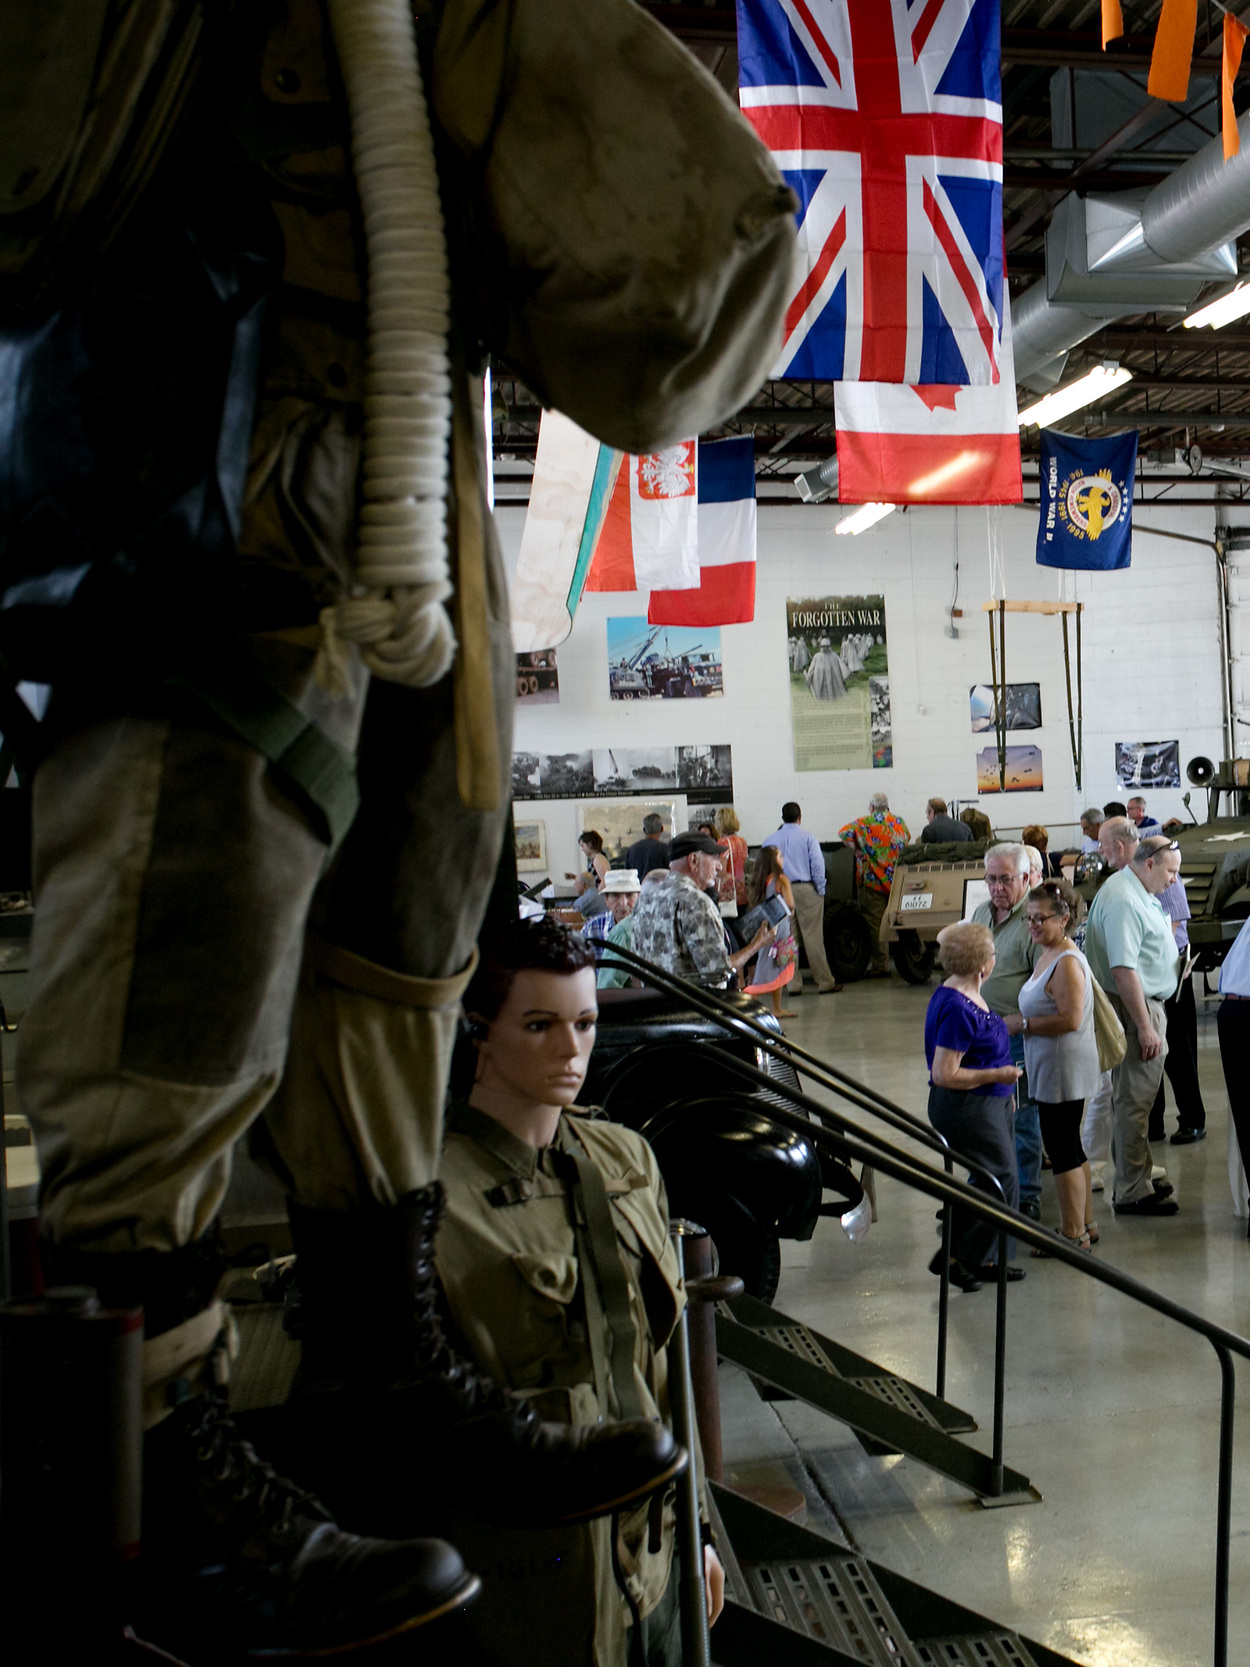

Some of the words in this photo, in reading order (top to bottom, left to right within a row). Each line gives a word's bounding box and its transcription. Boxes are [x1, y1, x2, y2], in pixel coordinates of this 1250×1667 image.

[1049, 456, 1058, 498] WORLD
[1046, 501, 1056, 529] WAR
[1066, 522, 1085, 540] 1995
[824, 602, 841, 611] THE
[792, 610, 856, 628] FORGOTTEN
[857, 609, 881, 626] WAR
